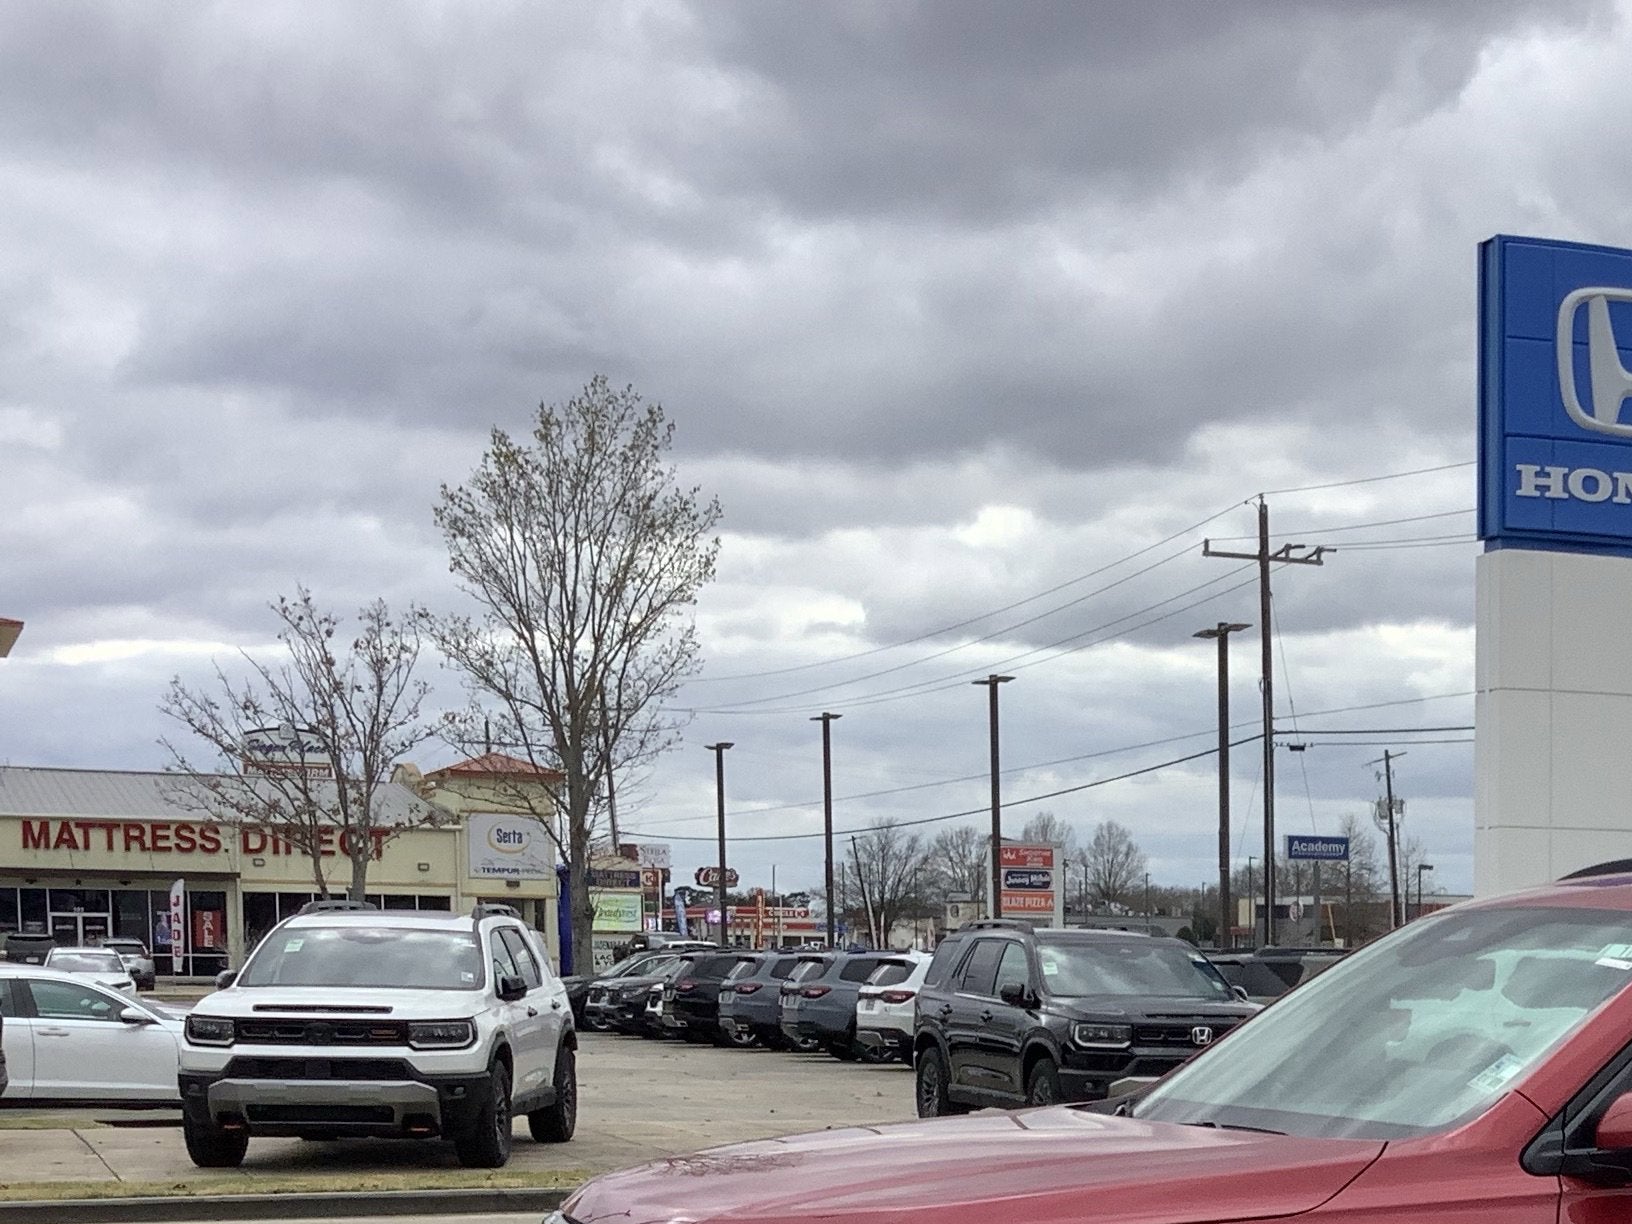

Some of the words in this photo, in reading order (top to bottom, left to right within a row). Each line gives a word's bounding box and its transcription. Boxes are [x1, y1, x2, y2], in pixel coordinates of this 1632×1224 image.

[21, 819, 222, 854] MATTRESS
[496, 828, 523, 844] Serta
[1291, 840, 1346, 856] Academy
